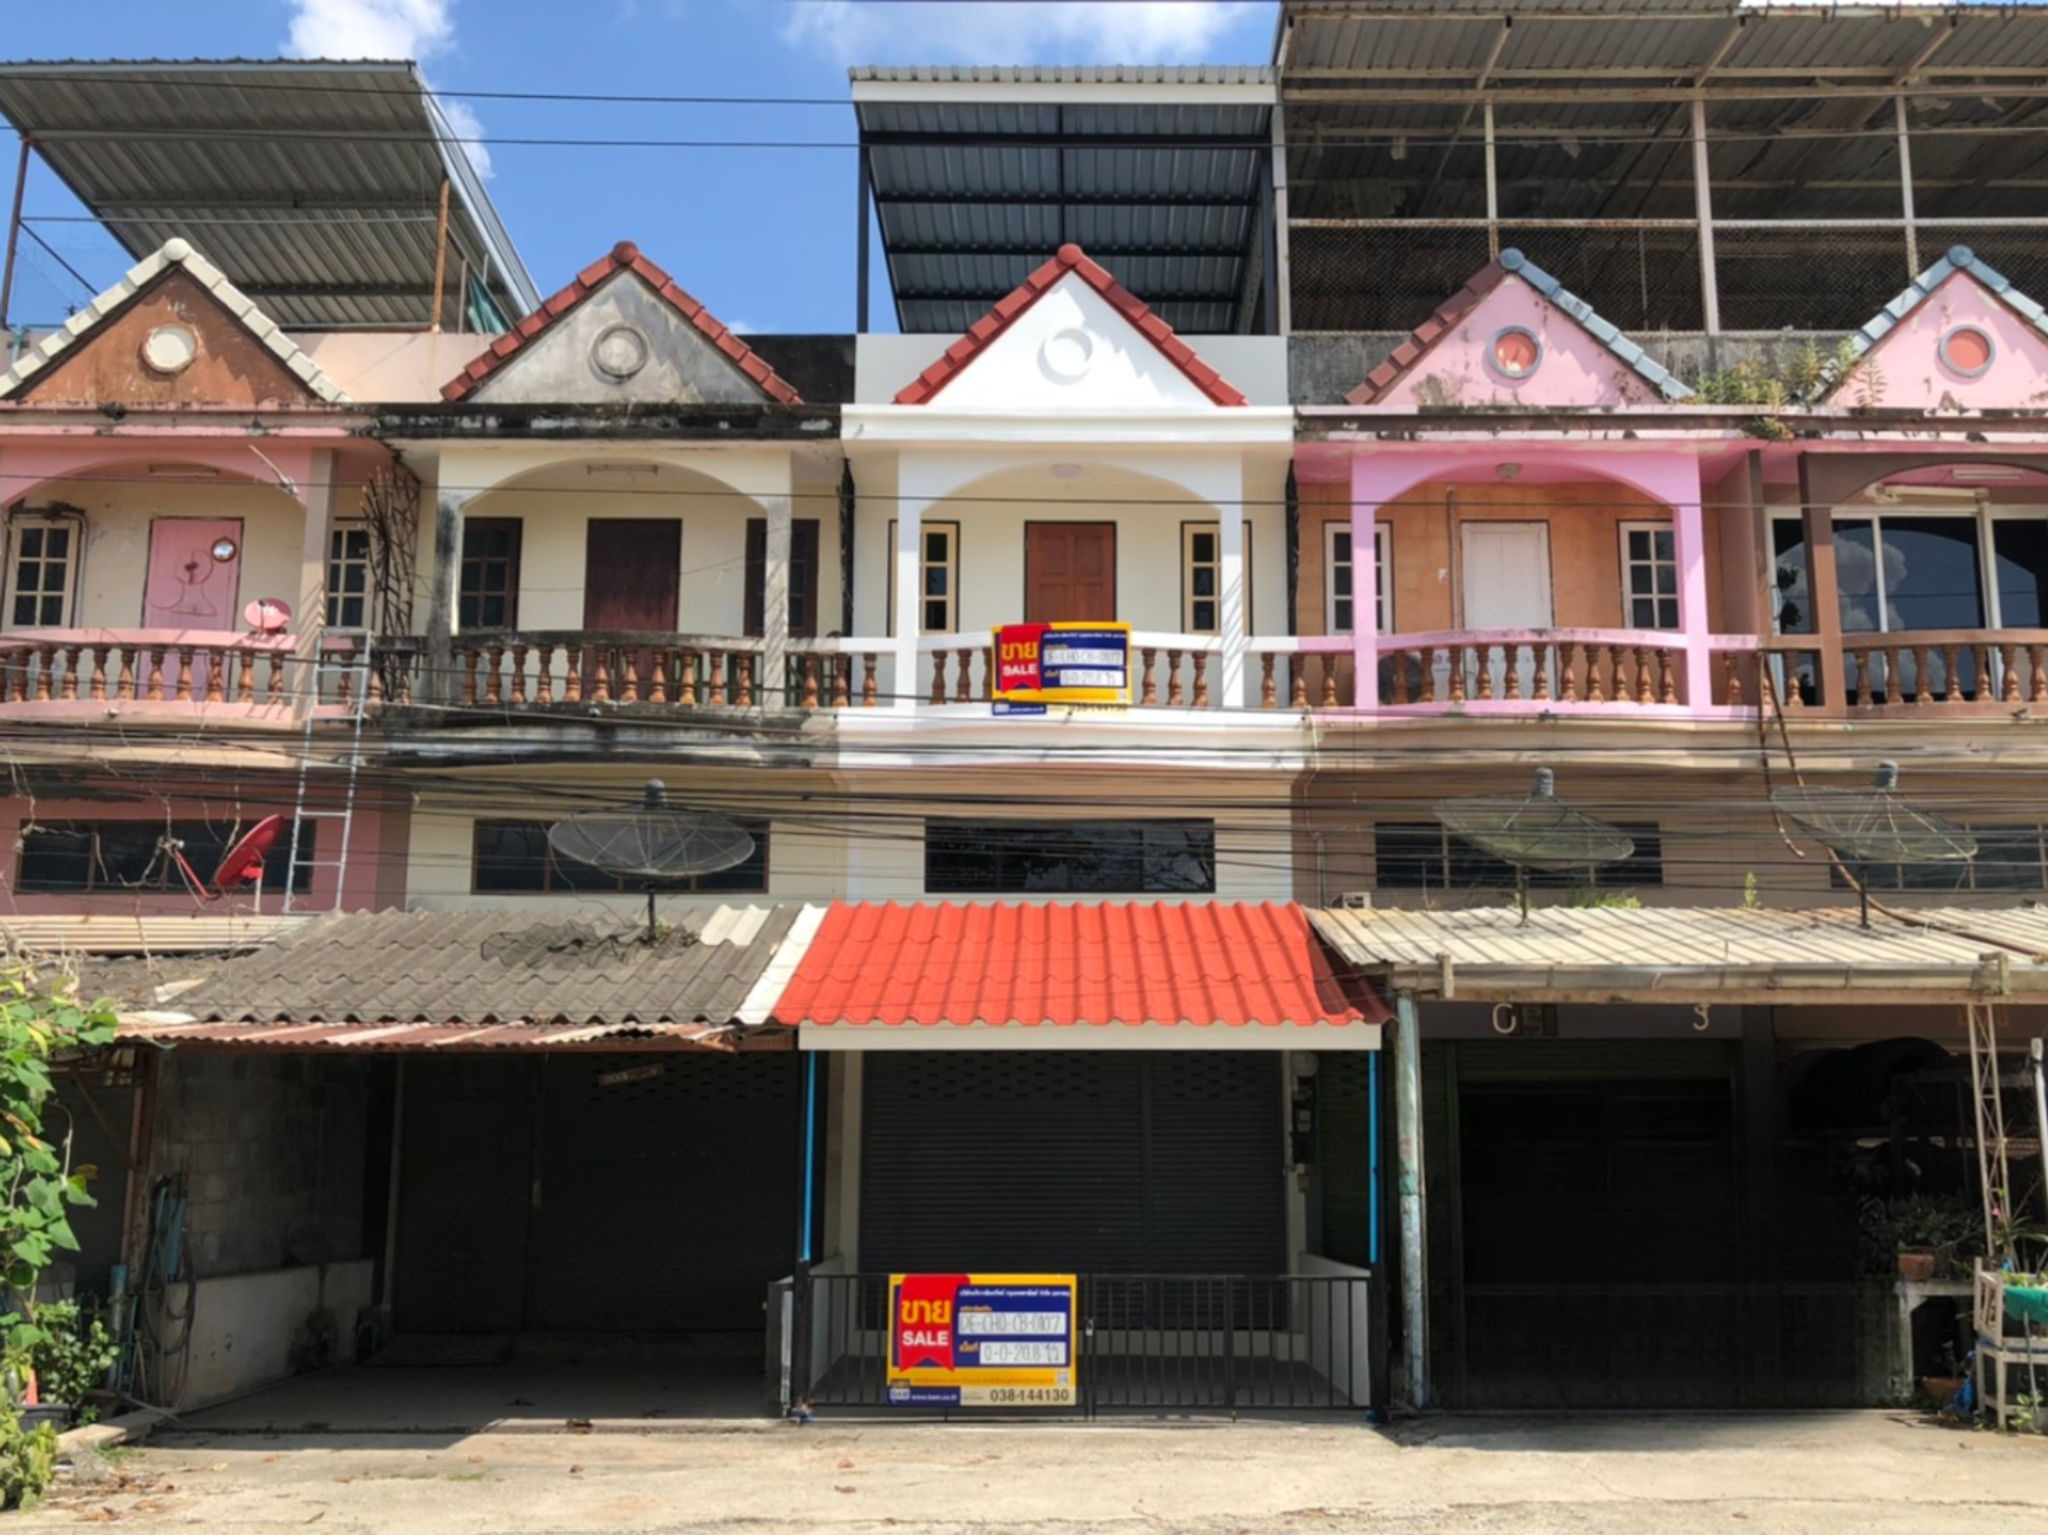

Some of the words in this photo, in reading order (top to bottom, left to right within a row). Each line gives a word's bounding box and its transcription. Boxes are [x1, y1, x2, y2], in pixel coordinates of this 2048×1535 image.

[1001, 641, 1038, 661] ขาย
[1002, 663, 1038, 677] SALE
[901, 1299, 951, 1324] ขาย
[902, 1330, 949, 1346] SALE
[990, 1388, 1070, 1402] 038-144130
